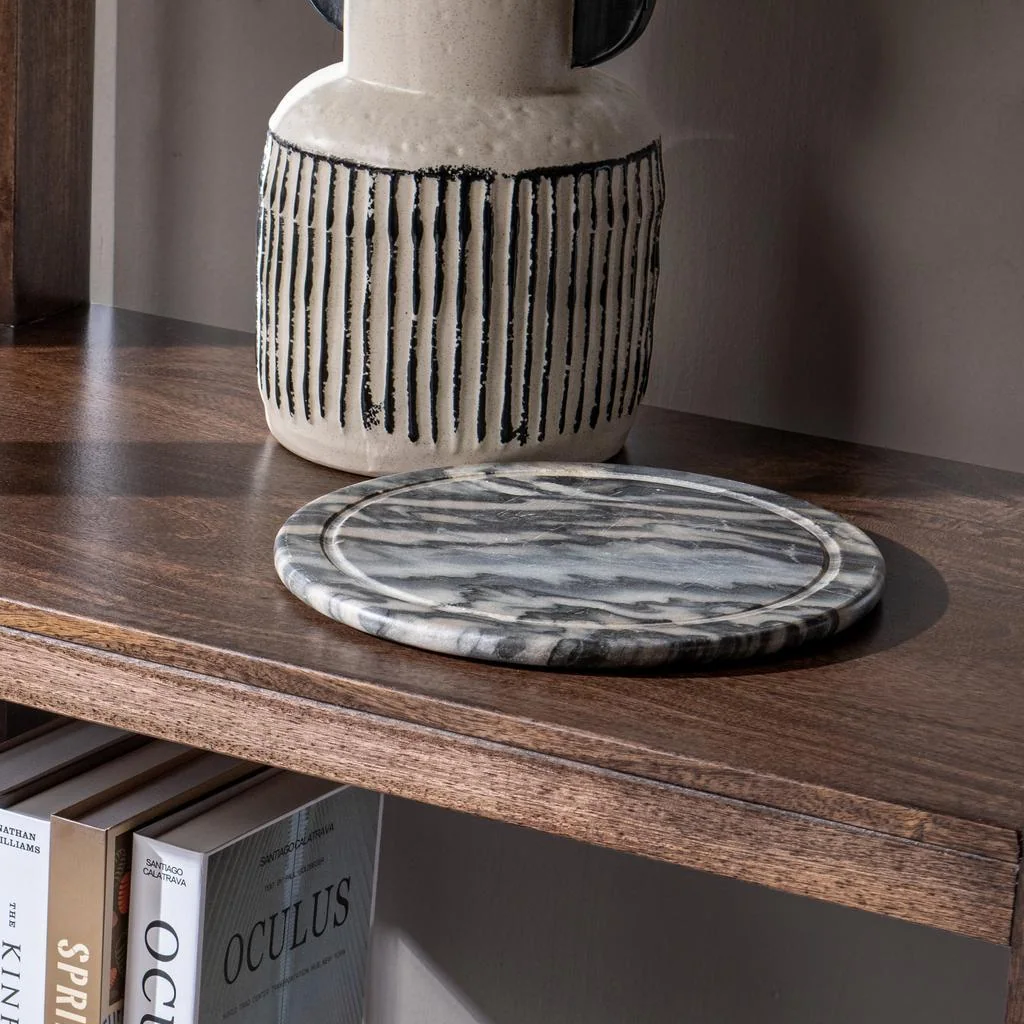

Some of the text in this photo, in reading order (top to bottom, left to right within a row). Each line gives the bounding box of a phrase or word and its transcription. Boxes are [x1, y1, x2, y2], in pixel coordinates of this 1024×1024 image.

[142, 867, 186, 887] CALATRAVA
[146, 858, 183, 876] SANTIAGO
[223, 876, 351, 984] OCULUS
